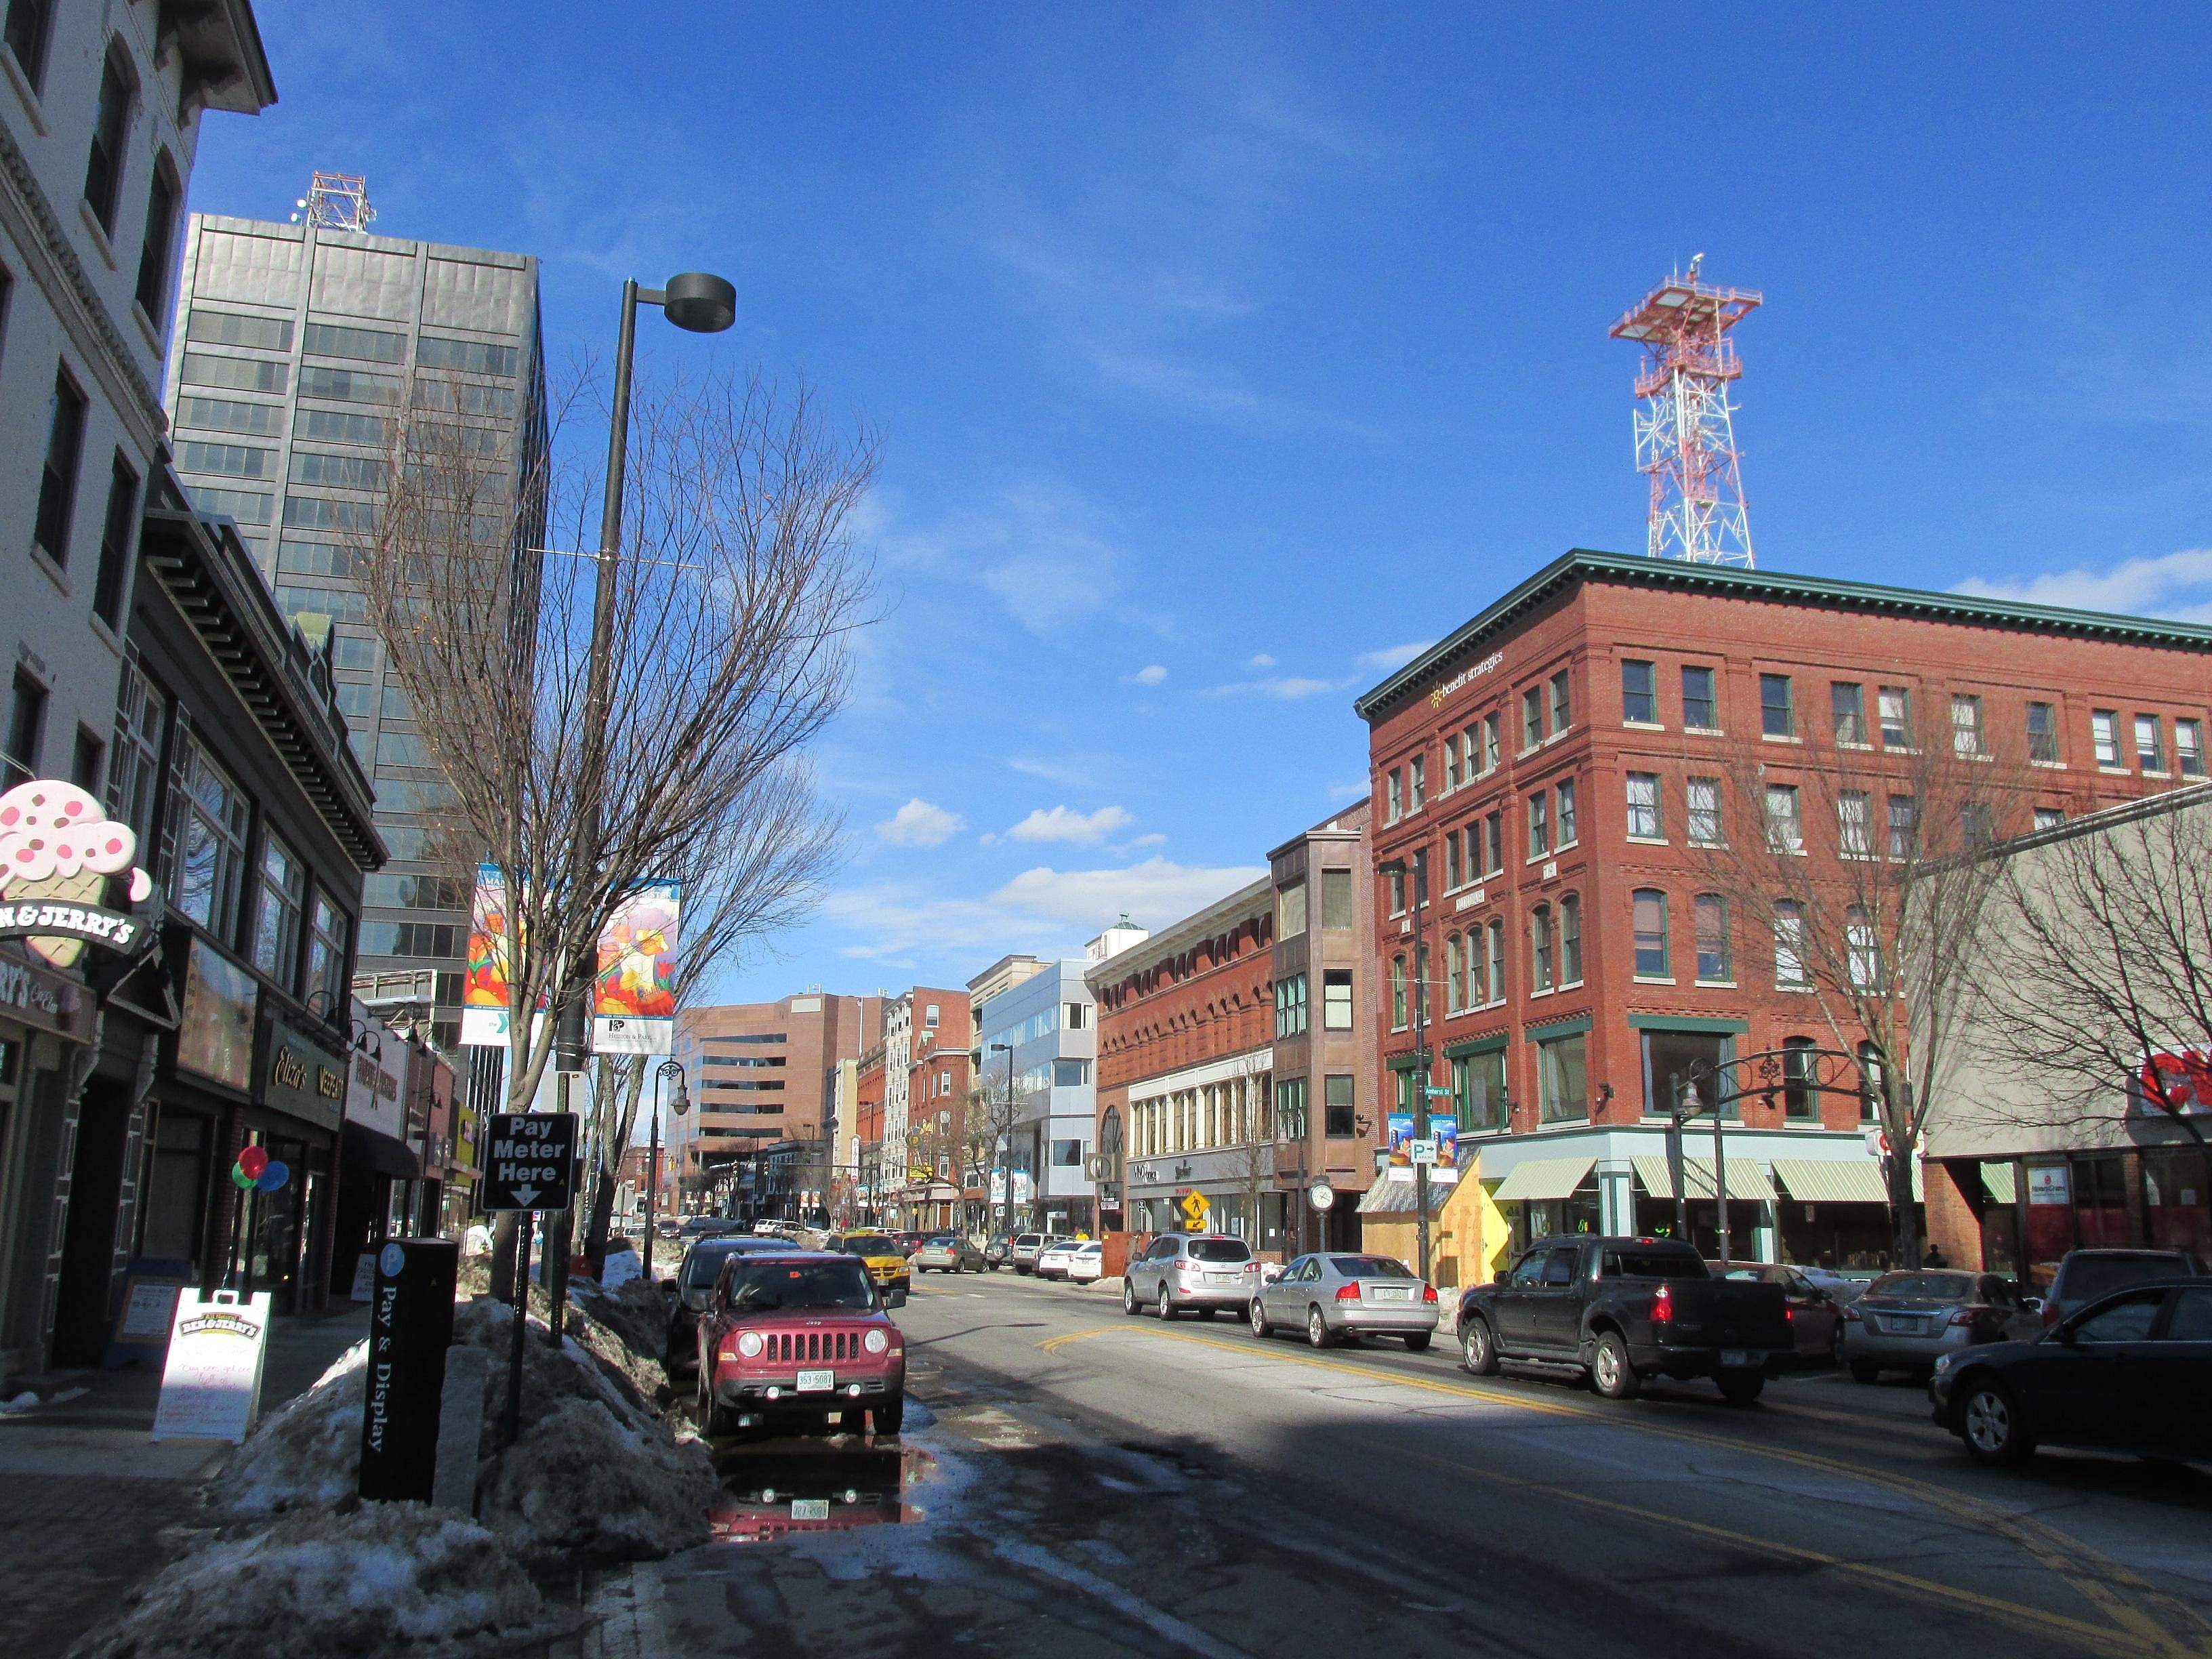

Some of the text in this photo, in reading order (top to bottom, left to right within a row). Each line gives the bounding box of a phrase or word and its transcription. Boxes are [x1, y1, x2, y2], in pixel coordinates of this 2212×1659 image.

[1442, 651, 1502, 697] benefit strategies
[17, 905, 39, 926] &
[38, 906, 136, 944] JERRY'S
[510, 1117, 552, 1139] Pay
[493, 1140, 565, 1158] Meter
[498, 1162, 556, 1181] Here
[183, 1319, 206, 1333] BEN
[206, 1319, 216, 1328] &
[216, 1319, 257, 1336] JERRY'S
[369, 1286, 397, 1453] Pay & Display
